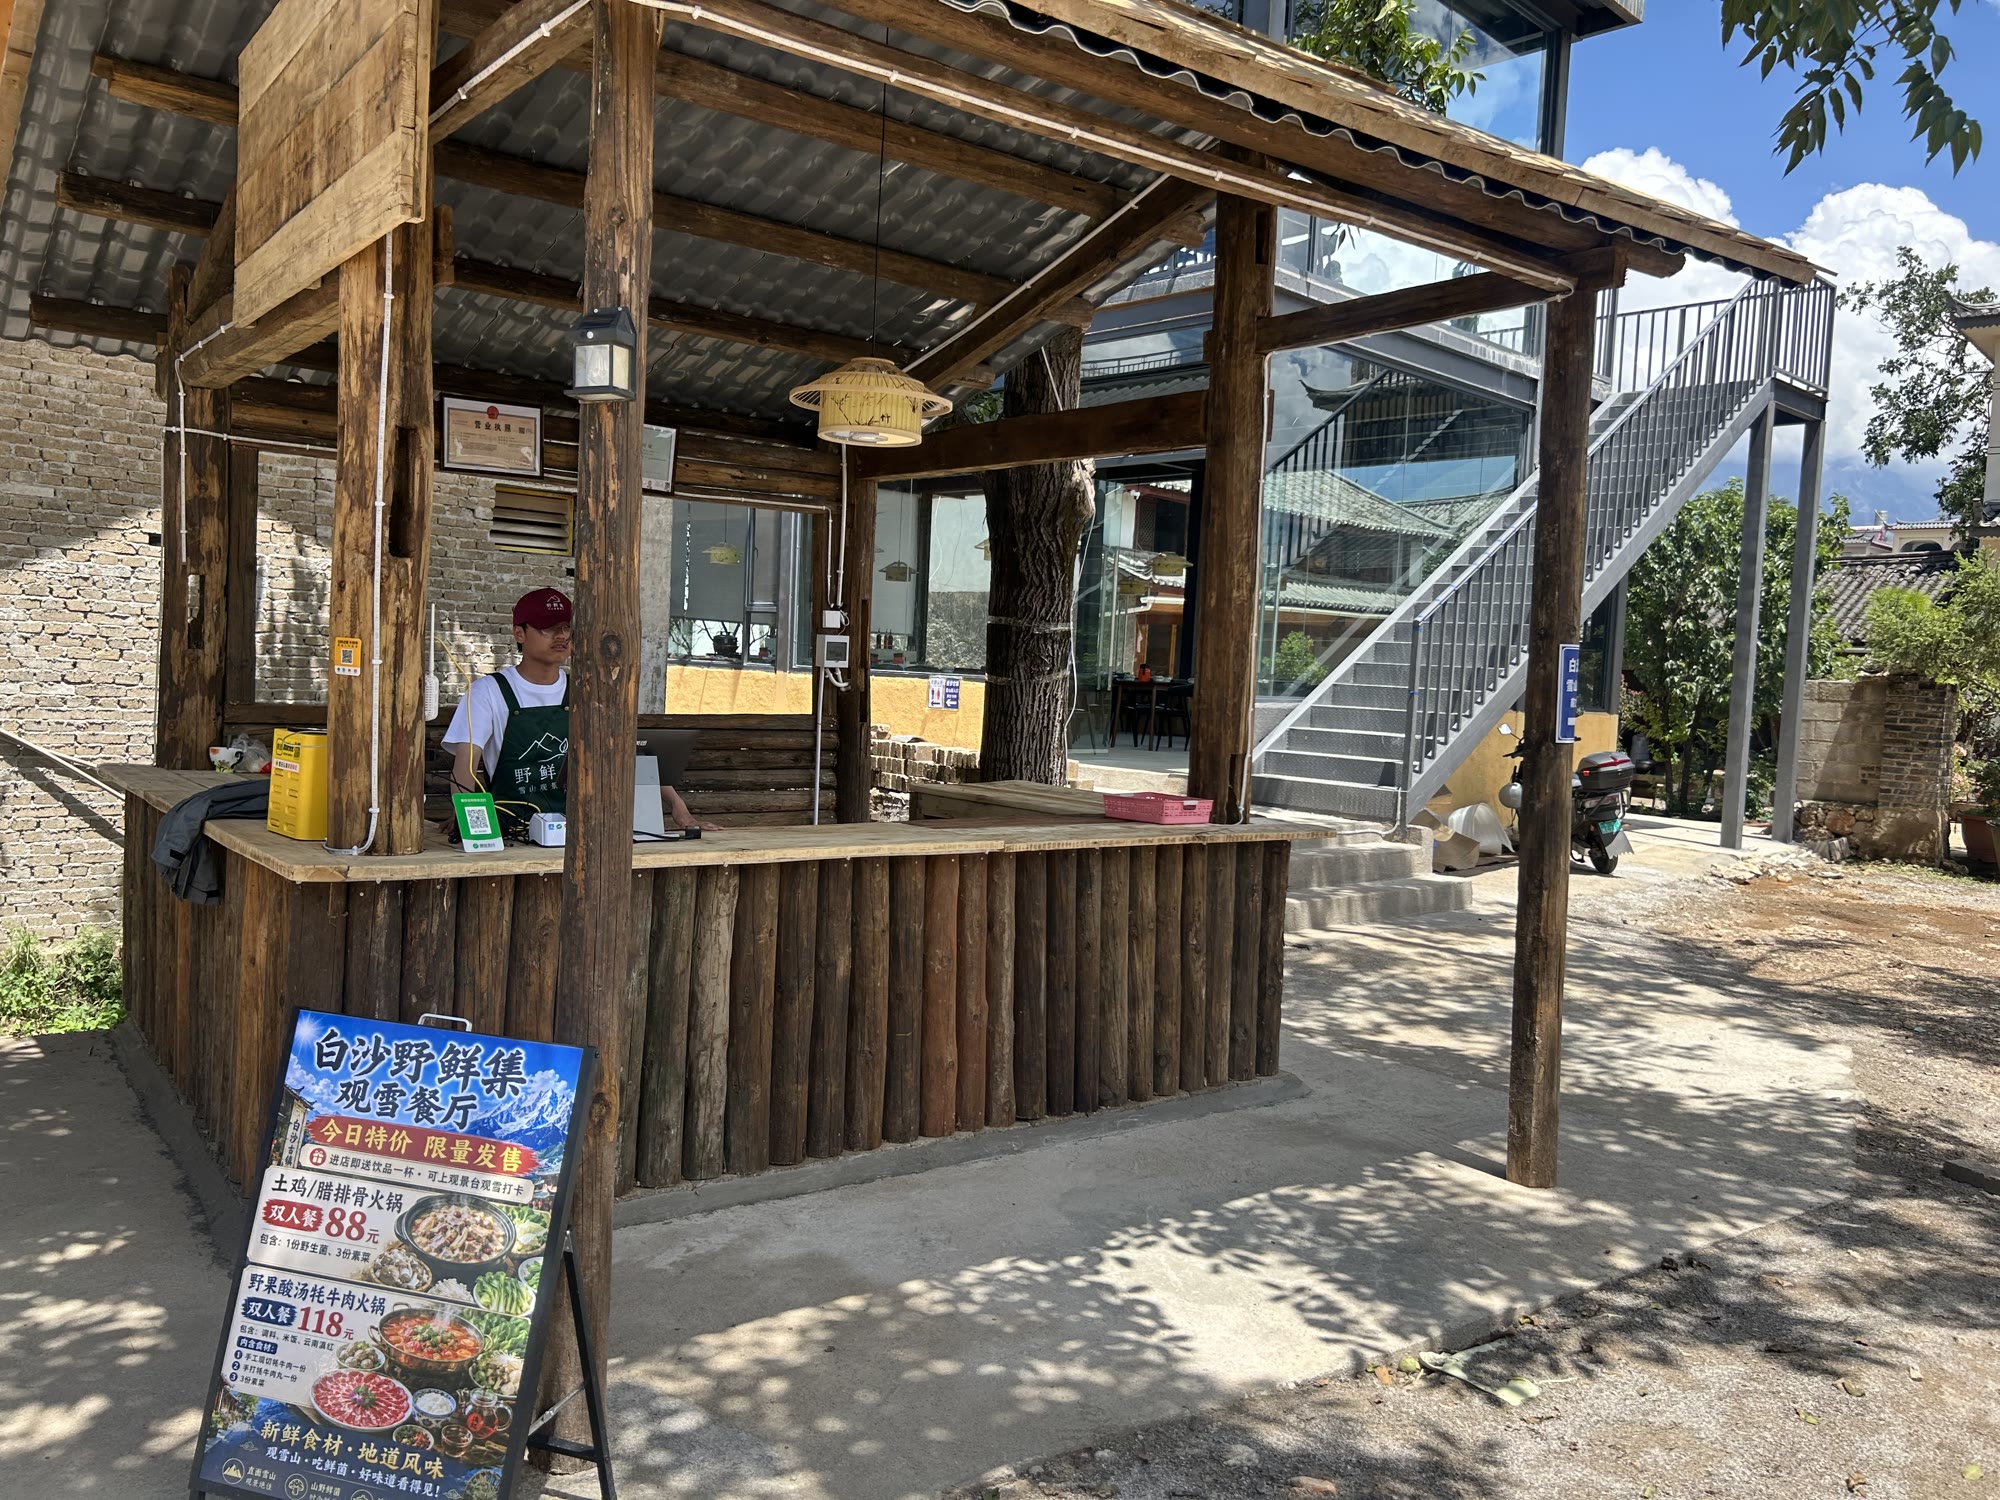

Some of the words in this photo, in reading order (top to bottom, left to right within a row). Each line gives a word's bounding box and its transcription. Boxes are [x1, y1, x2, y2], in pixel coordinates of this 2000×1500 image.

[474, 420, 512, 433] 营业执照
[315, 1028, 527, 1098] 白沙野鲜集
[334, 1079, 478, 1130] 观雪餐厅
[319, 1119, 413, 1155] 今日特价
[424, 1135, 523, 1173] 限量发售
[271, 1173, 404, 1214] 土鸡/腊排骨火锅
[268, 1204, 318, 1229] 双人餐
[246, 1302, 292, 1324] 双人餐
[248, 1273, 386, 1317] 野果酸汤牦牛肉火锅
[239, 1375, 265, 1387] 3份素菜
